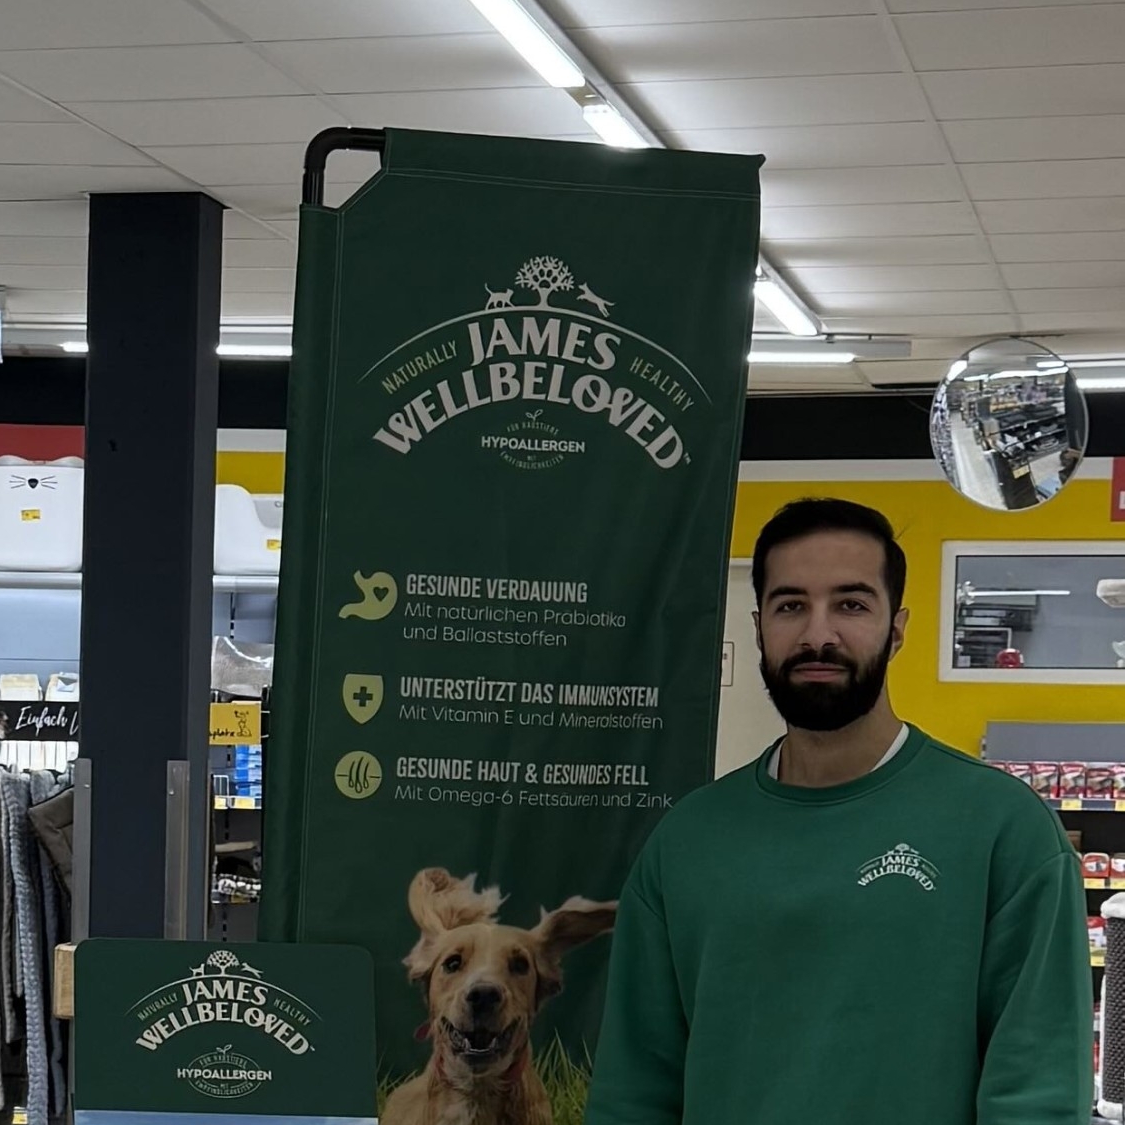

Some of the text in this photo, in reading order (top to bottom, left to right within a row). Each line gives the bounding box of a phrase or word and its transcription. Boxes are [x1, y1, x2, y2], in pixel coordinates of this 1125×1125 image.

[468, 317, 621, 371] JAMES
[381, 340, 458, 395] NATURALLY
[629, 357, 695, 413] HEALTHY
[481, 435, 586, 453] HYPOALLERGEN
[406, 573, 588, 603] GESUNDE VERDAUUNG
[404, 602, 432, 618] Mit
[437, 604, 538, 623] natürlichen
[403, 625, 567, 647] und Ballaststoffen
[400, 676, 659, 708] UNTERSTÜTZT DAS IMMUNSYSTEM
[15, 705, 68, 737] Einfach
[399, 705, 663, 730] Mit Vitamin E und Mineralstoffen
[396, 757, 649, 786] GESUNDE HAUT & GESUNDES FELL
[394, 785, 673, 809] Mit Omega-6 Fettsäuren und Zink
[882, 855, 921, 867] JAMES
[182, 979, 269, 1005] JAMES
[177, 1068, 272, 1081] HYPOALLERGEN
